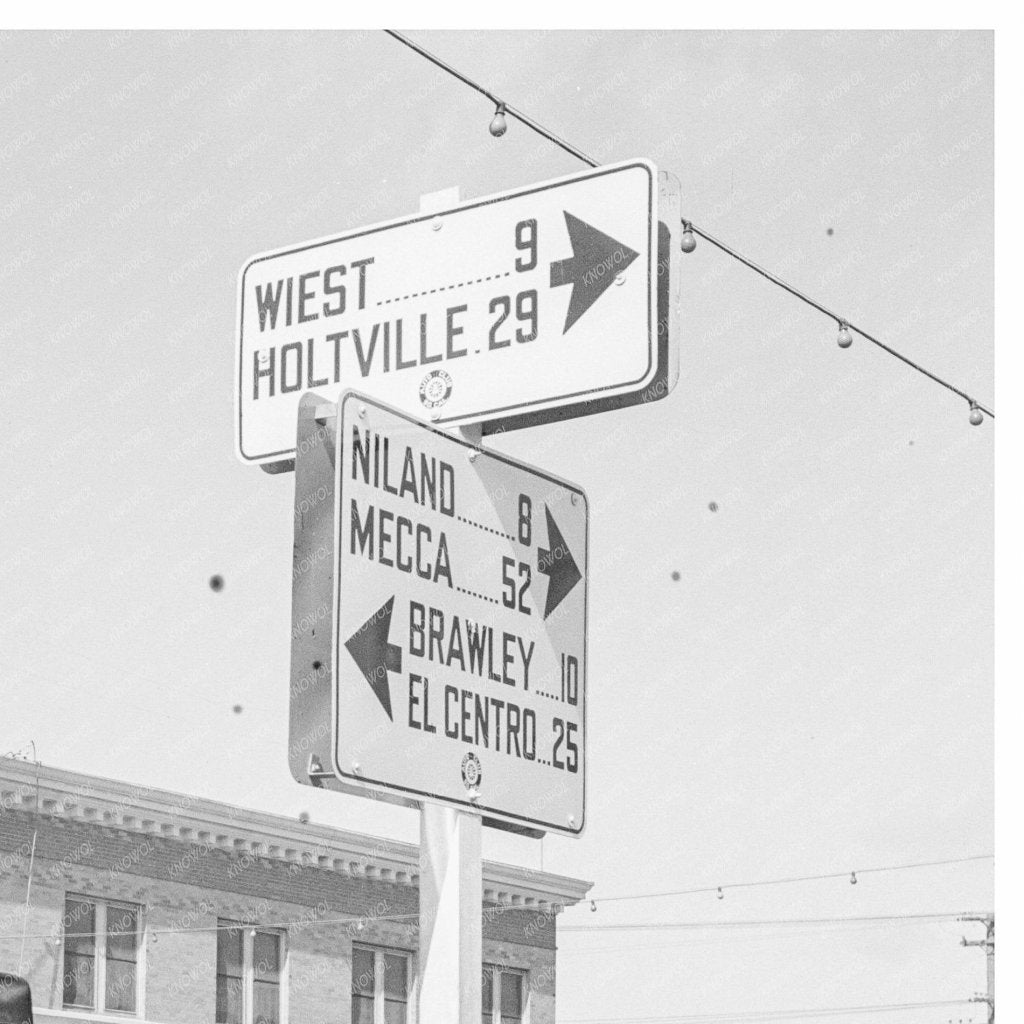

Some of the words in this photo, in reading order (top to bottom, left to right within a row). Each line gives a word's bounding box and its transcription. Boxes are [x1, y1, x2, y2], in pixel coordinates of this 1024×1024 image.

[255, 257, 375, 332] WIEST
[514, 218, 538, 272] 9
[488, 289, 538, 350] 29
[350, 425, 455, 517] NILAND
[518, 492, 532, 547] 8
[350, 498, 454, 589] MECCA
[502, 556, 532, 616] 52
[408, 600, 536, 692] BRAWLEY
[560, 652, 578, 706] 10
[408, 674, 437, 734] EL
[444, 685, 536, 762] CENTRO
[552, 716, 579, 774] 25
